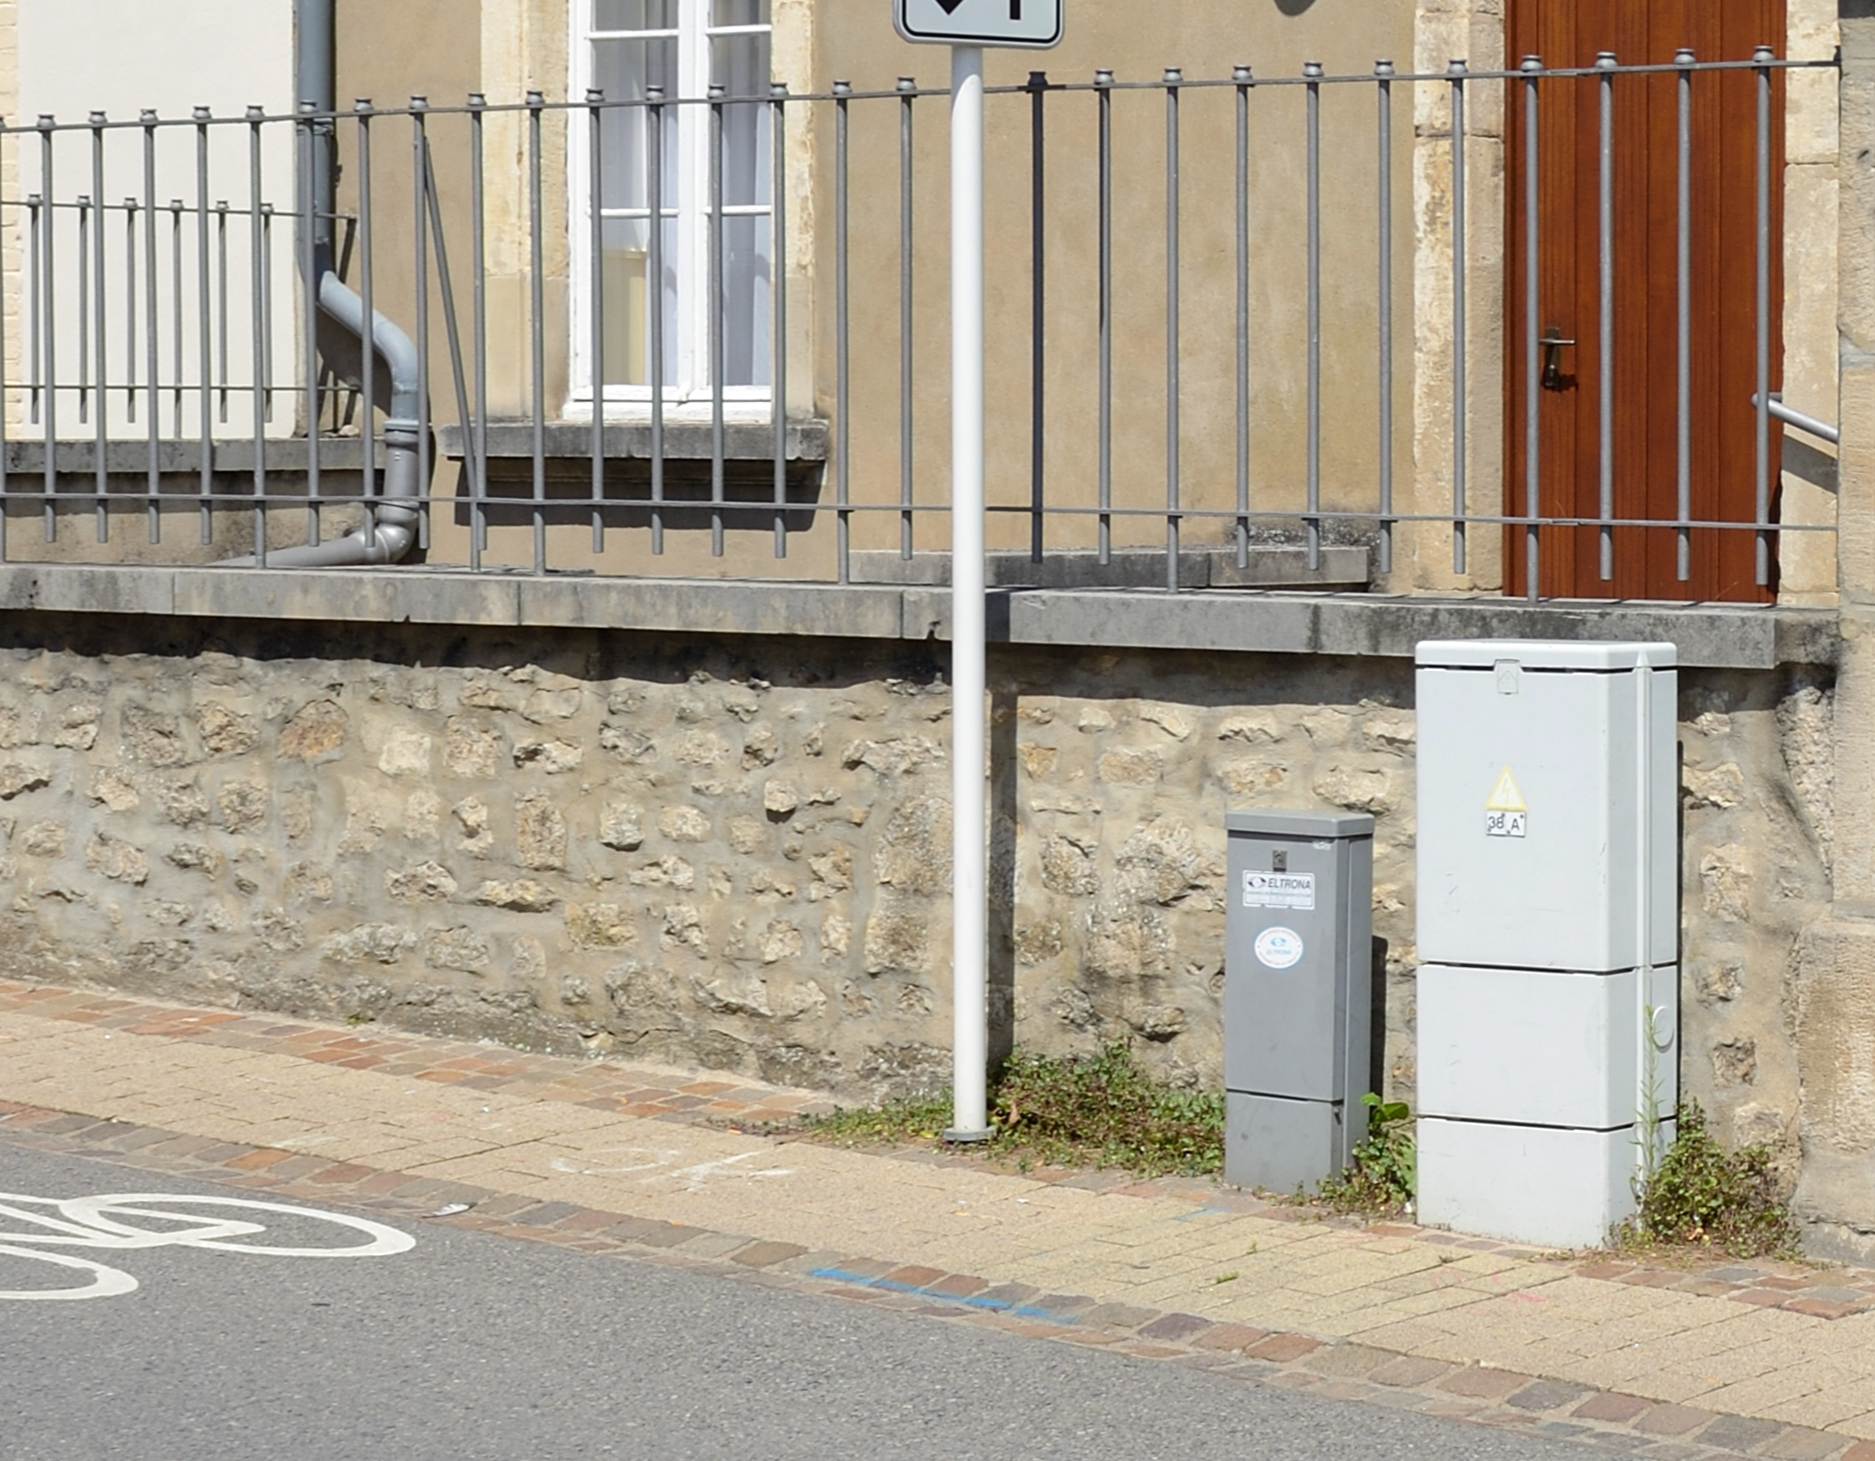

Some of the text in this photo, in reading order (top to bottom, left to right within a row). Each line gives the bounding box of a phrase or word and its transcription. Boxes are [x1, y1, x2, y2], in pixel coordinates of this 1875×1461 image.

[1488, 816, 1520, 830] 38 A
[1268, 877, 1311, 889] ELTRONA
